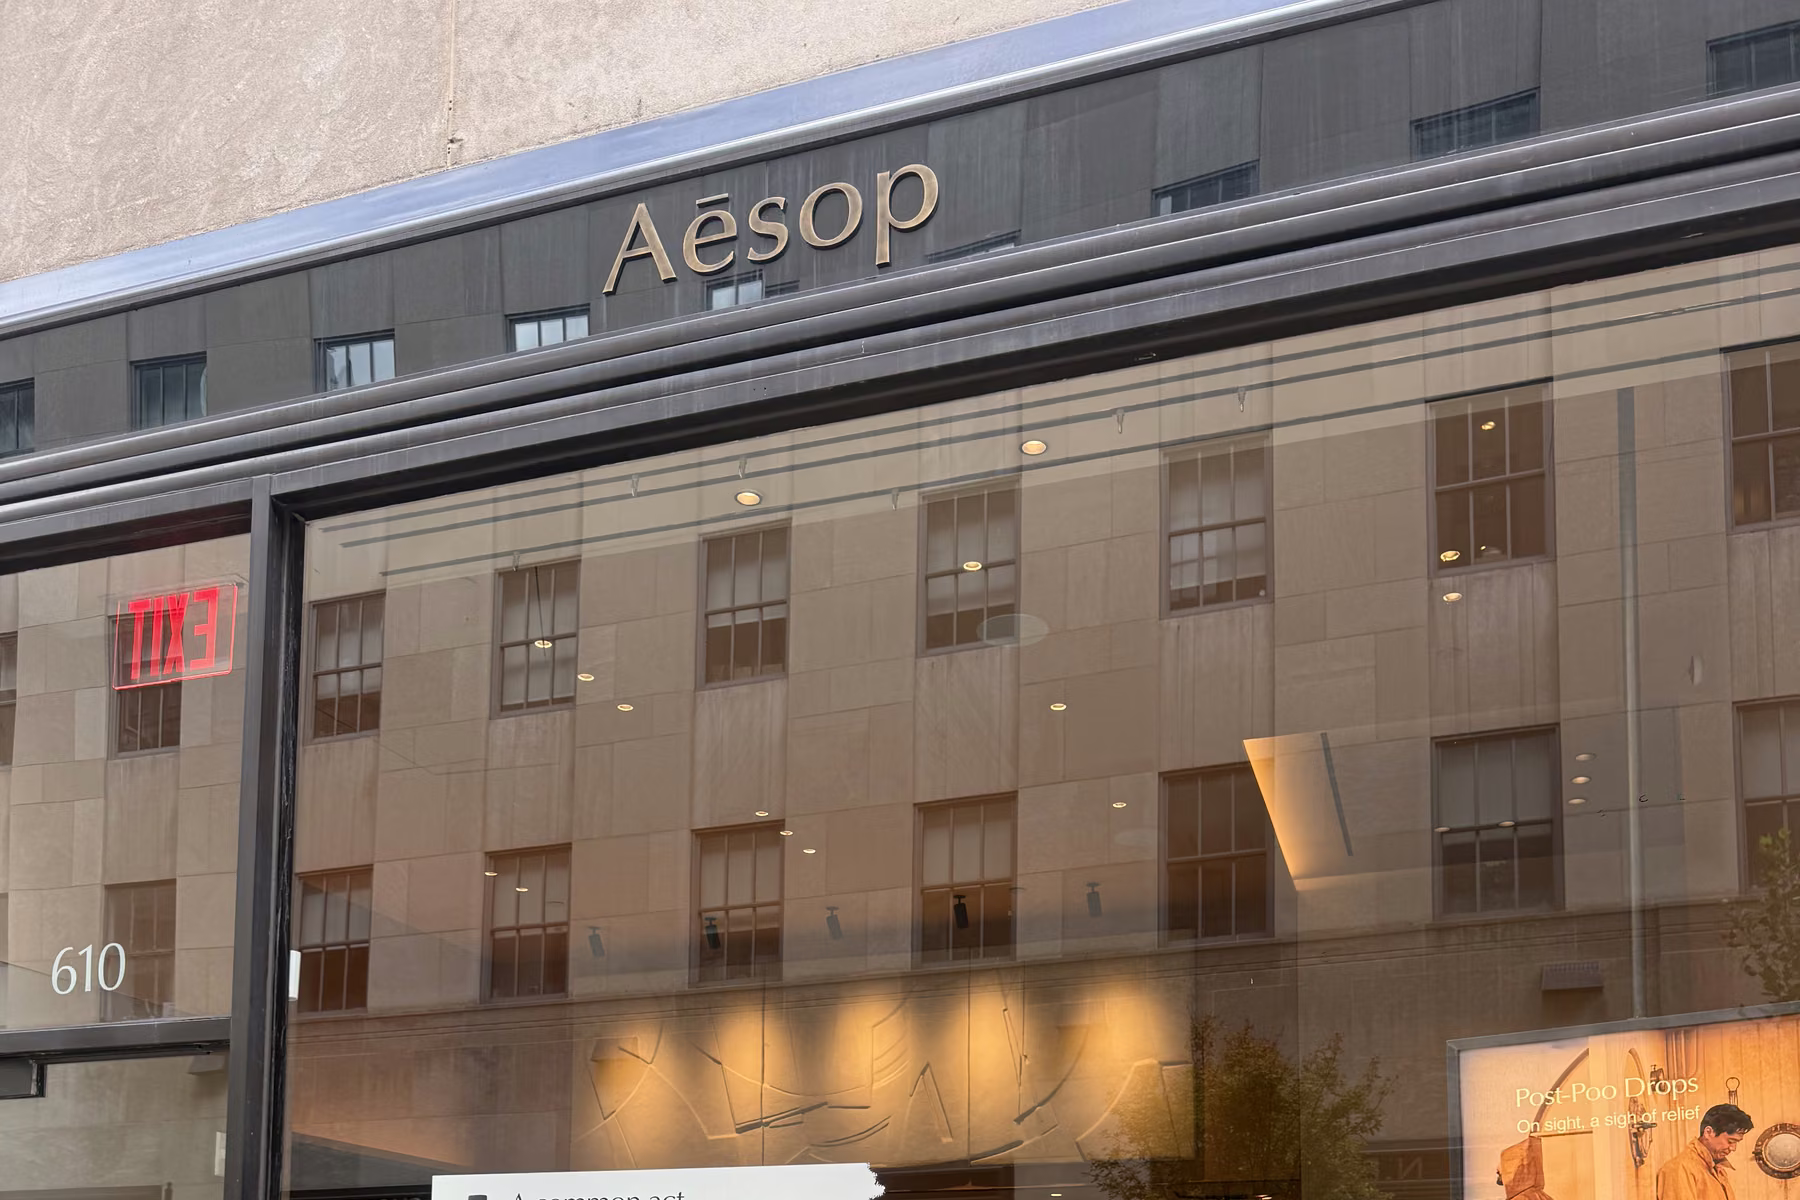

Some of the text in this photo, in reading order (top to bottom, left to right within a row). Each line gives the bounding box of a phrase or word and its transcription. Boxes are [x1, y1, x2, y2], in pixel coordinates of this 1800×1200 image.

[602, 163, 940, 296] Aēsop
[51, 942, 126, 995] 610
[1515, 1077, 1699, 1108] Post-Poo Drops
[1517, 1105, 1700, 1133] On sight, a sigh of relief
